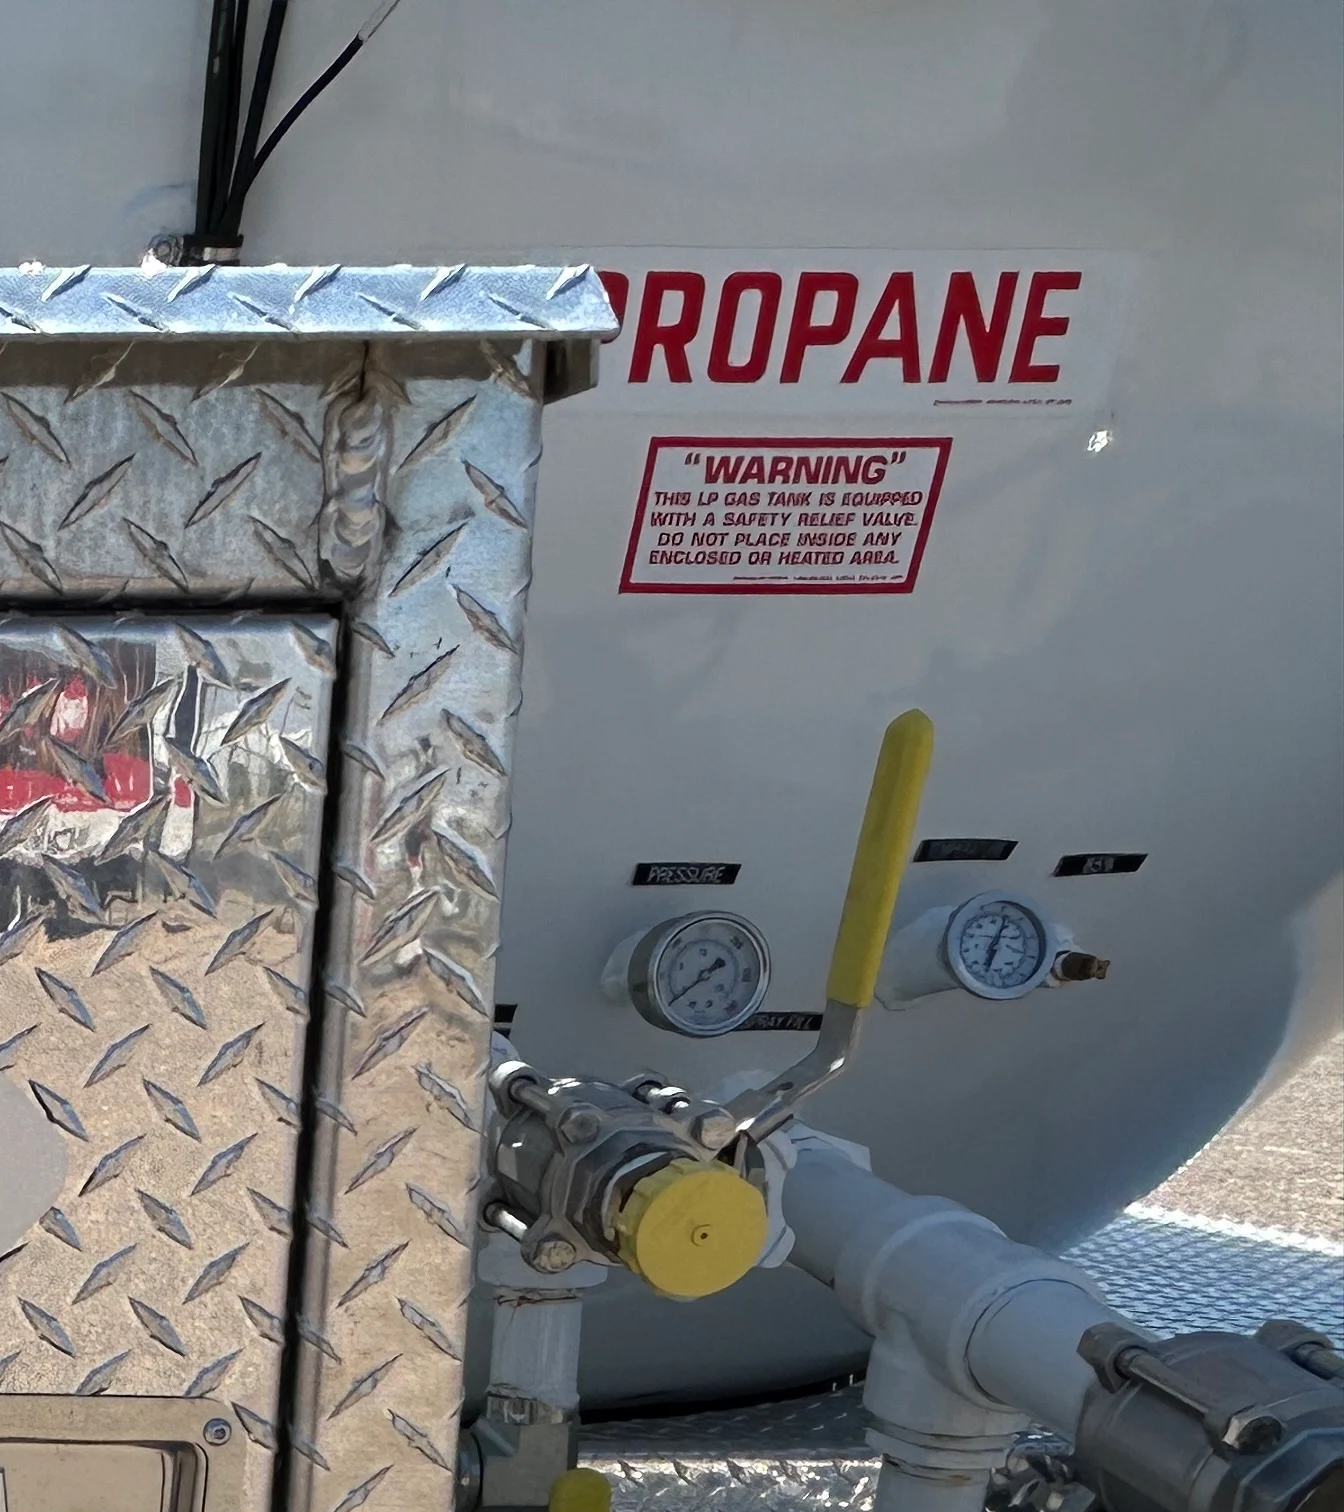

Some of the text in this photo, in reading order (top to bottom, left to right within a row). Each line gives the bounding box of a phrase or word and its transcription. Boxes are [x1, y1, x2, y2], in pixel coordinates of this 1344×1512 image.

[654, 491, 924, 506] THIS LP GAS TANK IS EQUIPPED
[650, 512, 696, 527] WITH
[702, 512, 715, 527] A
[722, 512, 791, 527] SAFETY
[797, 512, 856, 527] RELIEF
[657, 532, 902, 547] DO NOT PLACE INSIDE ANY
[649, 550, 741, 565] ENCLOSED
[748, 550, 772, 565] OR
[778, 550, 844, 565] HEATED
[646, 865, 726, 884] PRESSURE
